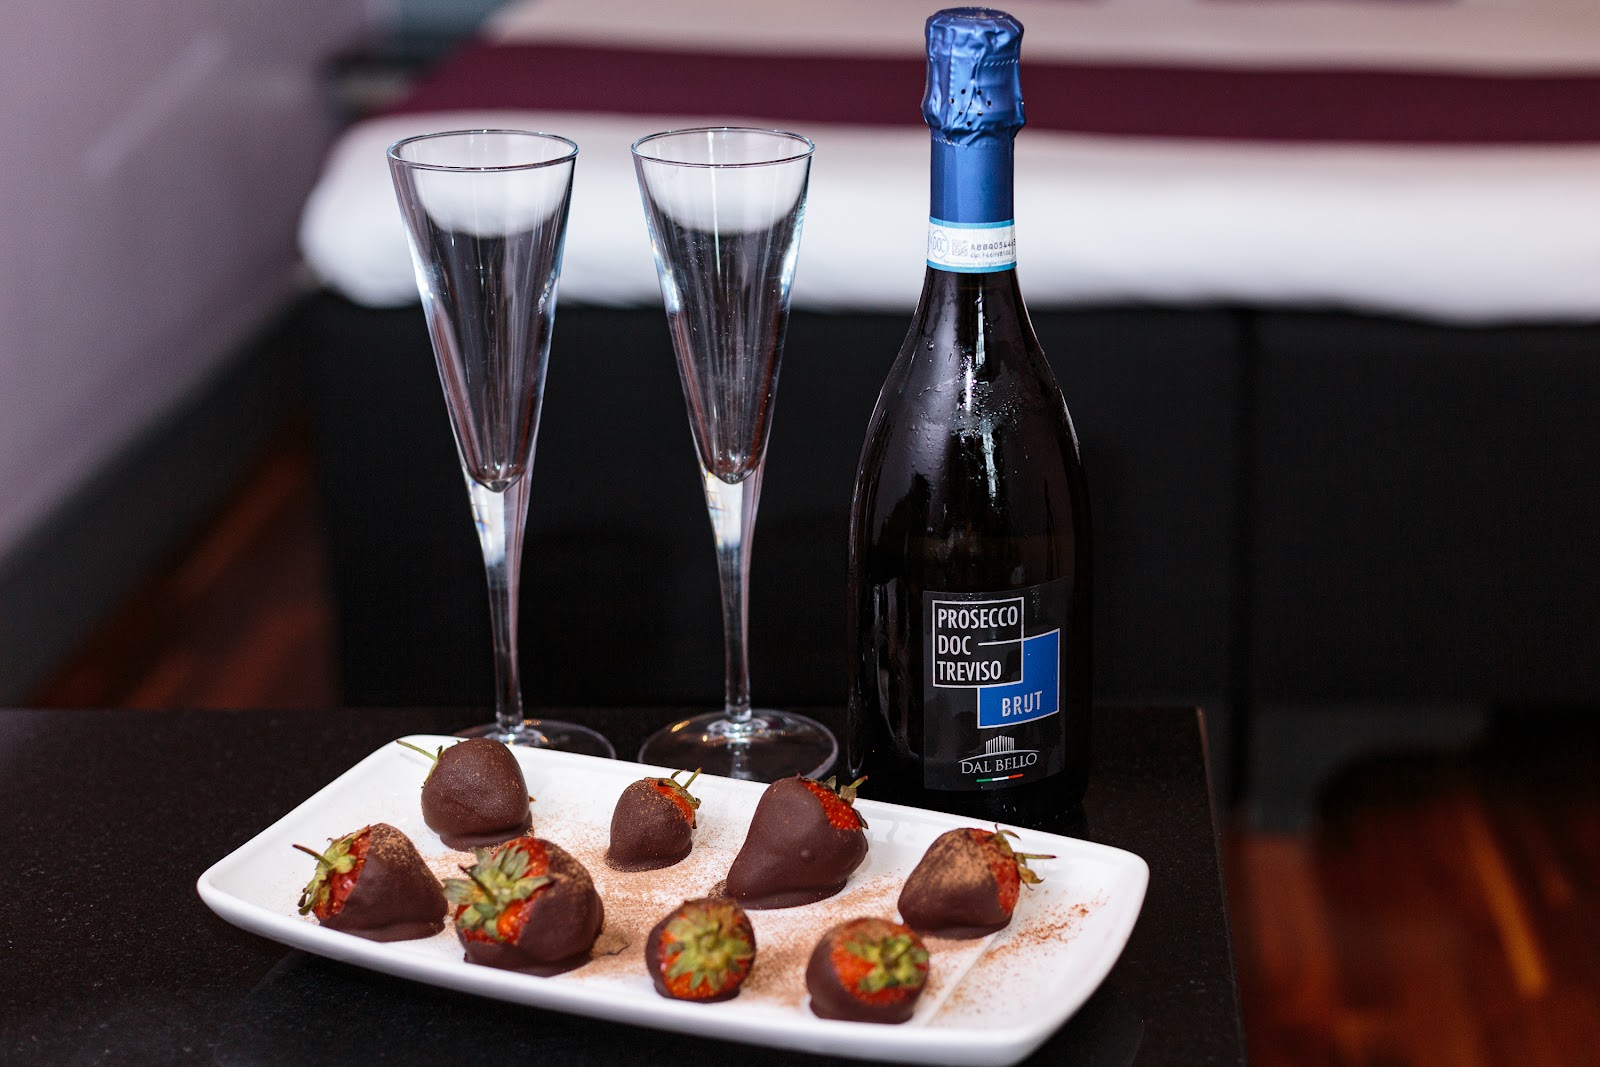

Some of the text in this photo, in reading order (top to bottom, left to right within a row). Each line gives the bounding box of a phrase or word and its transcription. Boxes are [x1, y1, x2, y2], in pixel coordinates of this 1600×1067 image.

[932, 236, 946, 253] DOC
[937, 605, 1019, 630] PROSECCO
[938, 634, 972, 656] DOC
[936, 660, 1002, 682] TREVISO
[1001, 690, 1043, 718] BRUT
[961, 752, 1038, 774] DAL BELLO
